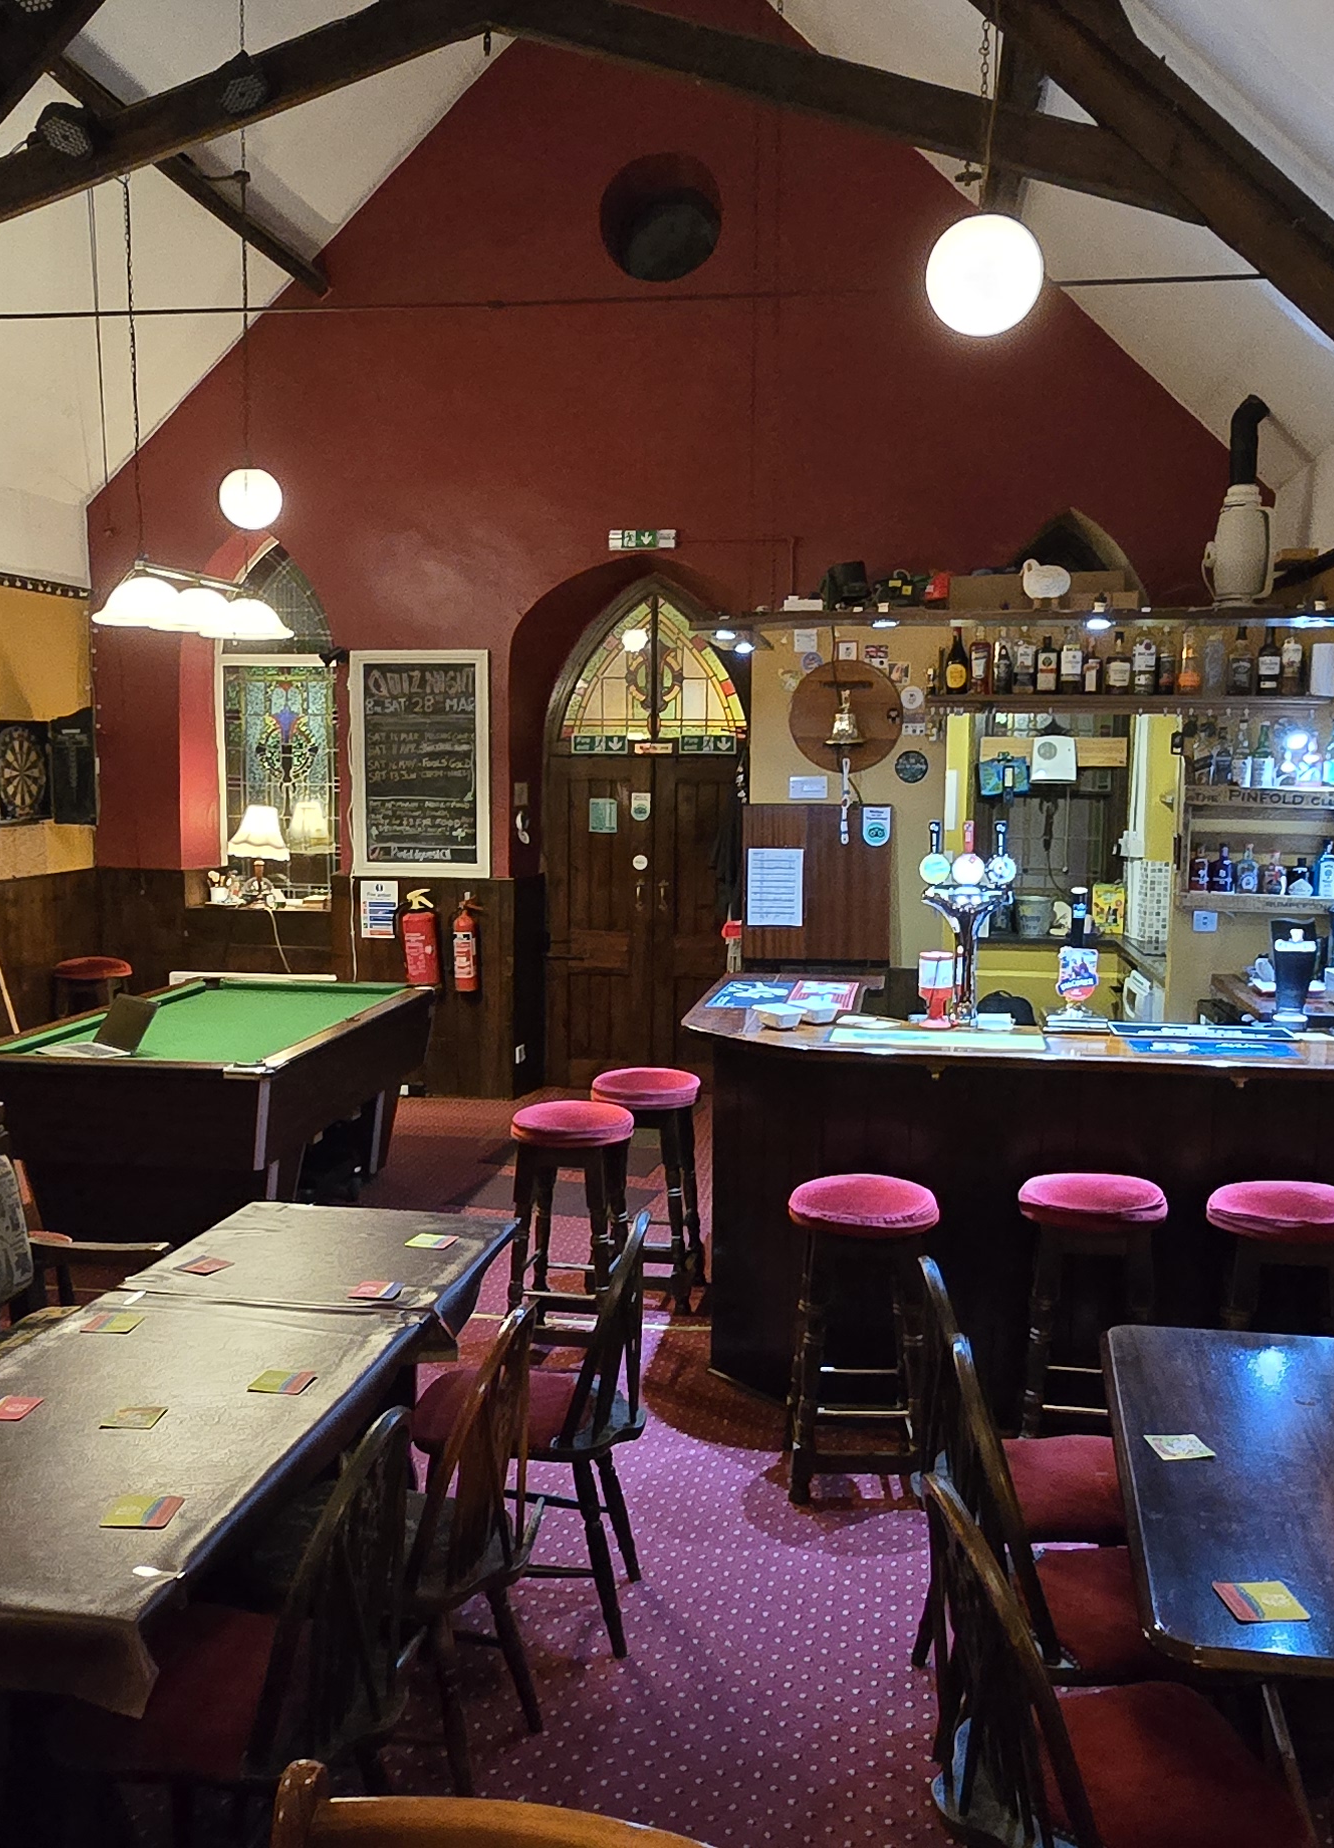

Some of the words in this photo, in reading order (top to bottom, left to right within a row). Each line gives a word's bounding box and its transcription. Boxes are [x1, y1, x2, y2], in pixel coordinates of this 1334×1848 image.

[367, 669, 423, 698] QUIZ
[425, 668, 475, 696] NIGHT
[384, 698, 407, 713] SAT
[444, 697, 475, 712] MAR
[368, 732, 386, 743] SAT
[368, 760, 386, 771] SAT
[449, 758, 471, 769] GOLD
[368, 770, 387, 783] SAT
[1228, 789, 1305, 806] PINFOLD
